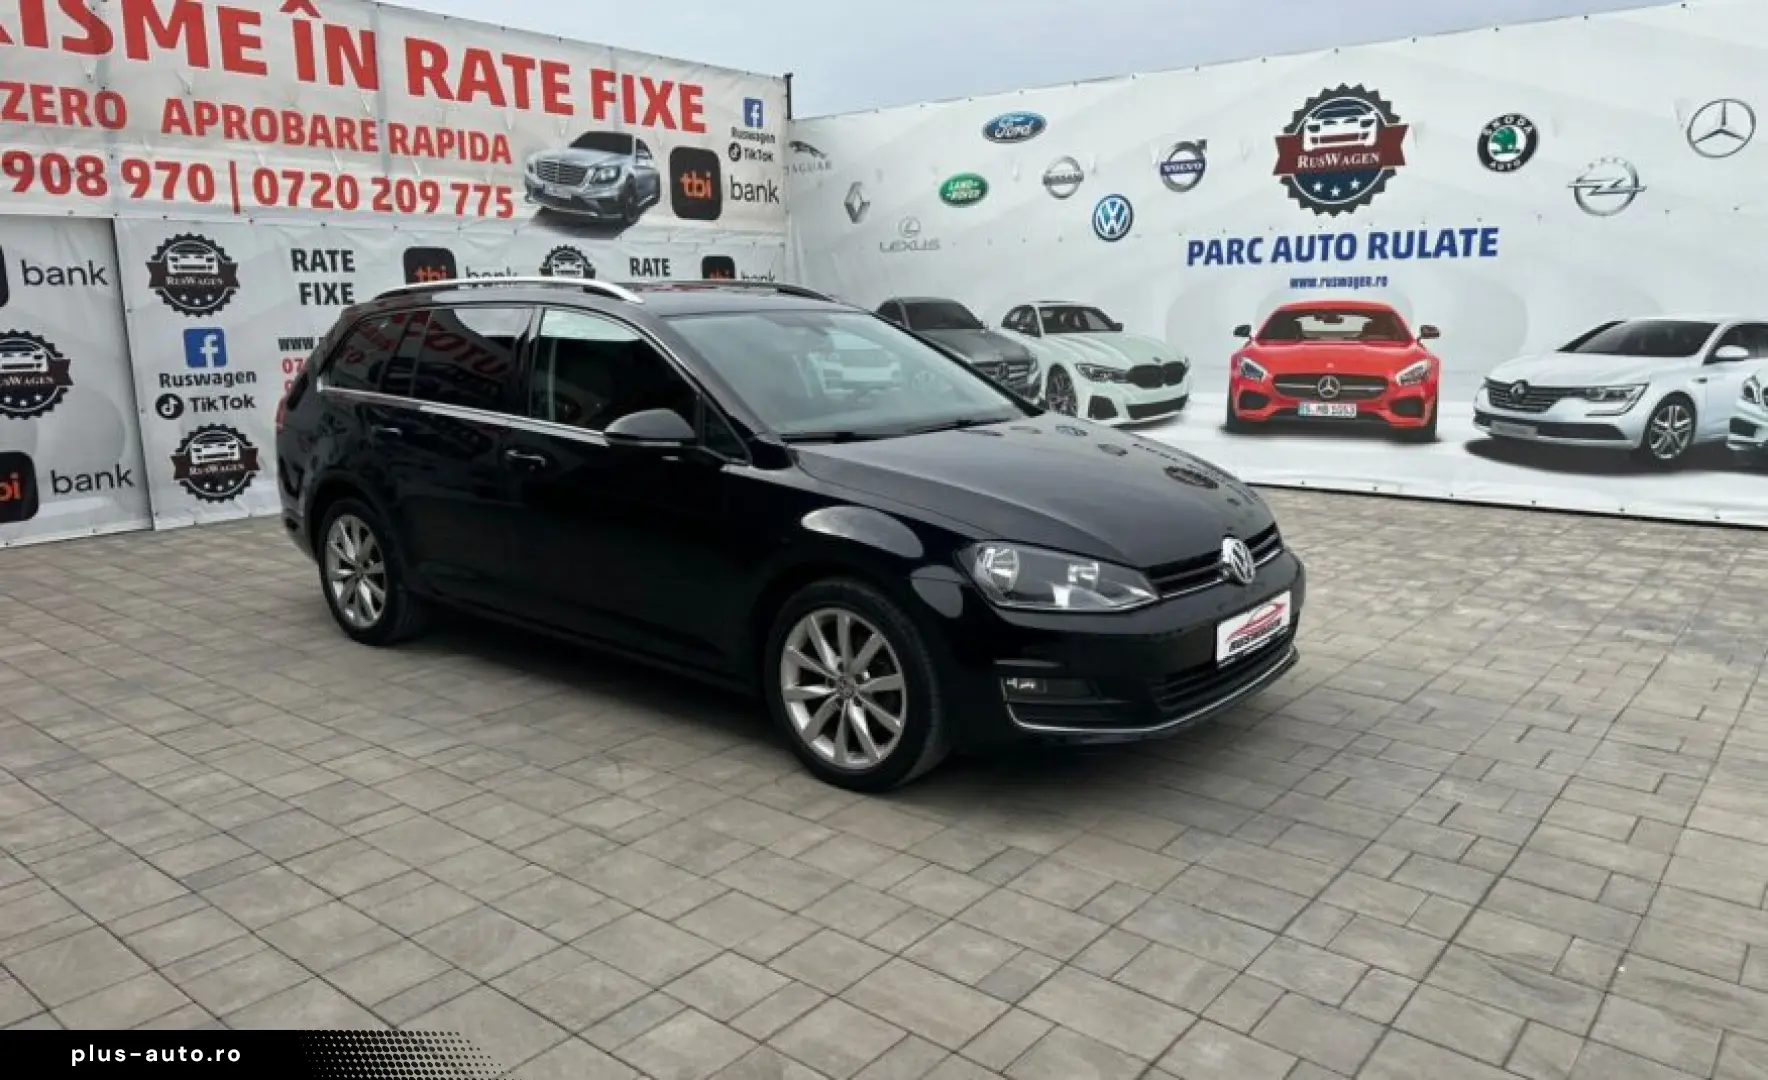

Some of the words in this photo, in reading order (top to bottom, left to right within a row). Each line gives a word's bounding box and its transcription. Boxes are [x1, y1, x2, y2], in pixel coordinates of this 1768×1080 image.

[0, 0, 267, 76] ISME
[404, 37, 574, 116] RATE
[590, 68, 707, 134] FIXE
[0, 81, 128, 130] ZERO
[161, 97, 379, 152] APROBARE
[387, 122, 512, 164] RAPIDA
[1163, 162, 1203, 173] VOLVO
[1, 150, 108, 197] 908
[120, 159, 215, 203] 970
[253, 167, 359, 211] 0720
[370, 176, 441, 214] 209
[451, 183, 515, 219] 775
[680, 170, 712, 198] tbi
[730, 175, 780, 204] bank
[290, 248, 356, 273] RATE
[1186, 237, 1264, 266] PARC
[1271, 232, 1358, 263] AUTO
[1367, 227, 1499, 260] RULATE
[20, 258, 109, 287] bank
[629, 257, 671, 277] RATE
[299, 282, 355, 305] FIXE
[159, 370, 257, 389] Ruswagen
[189, 393, 256, 413] TikTok
[50, 464, 136, 494] bank
